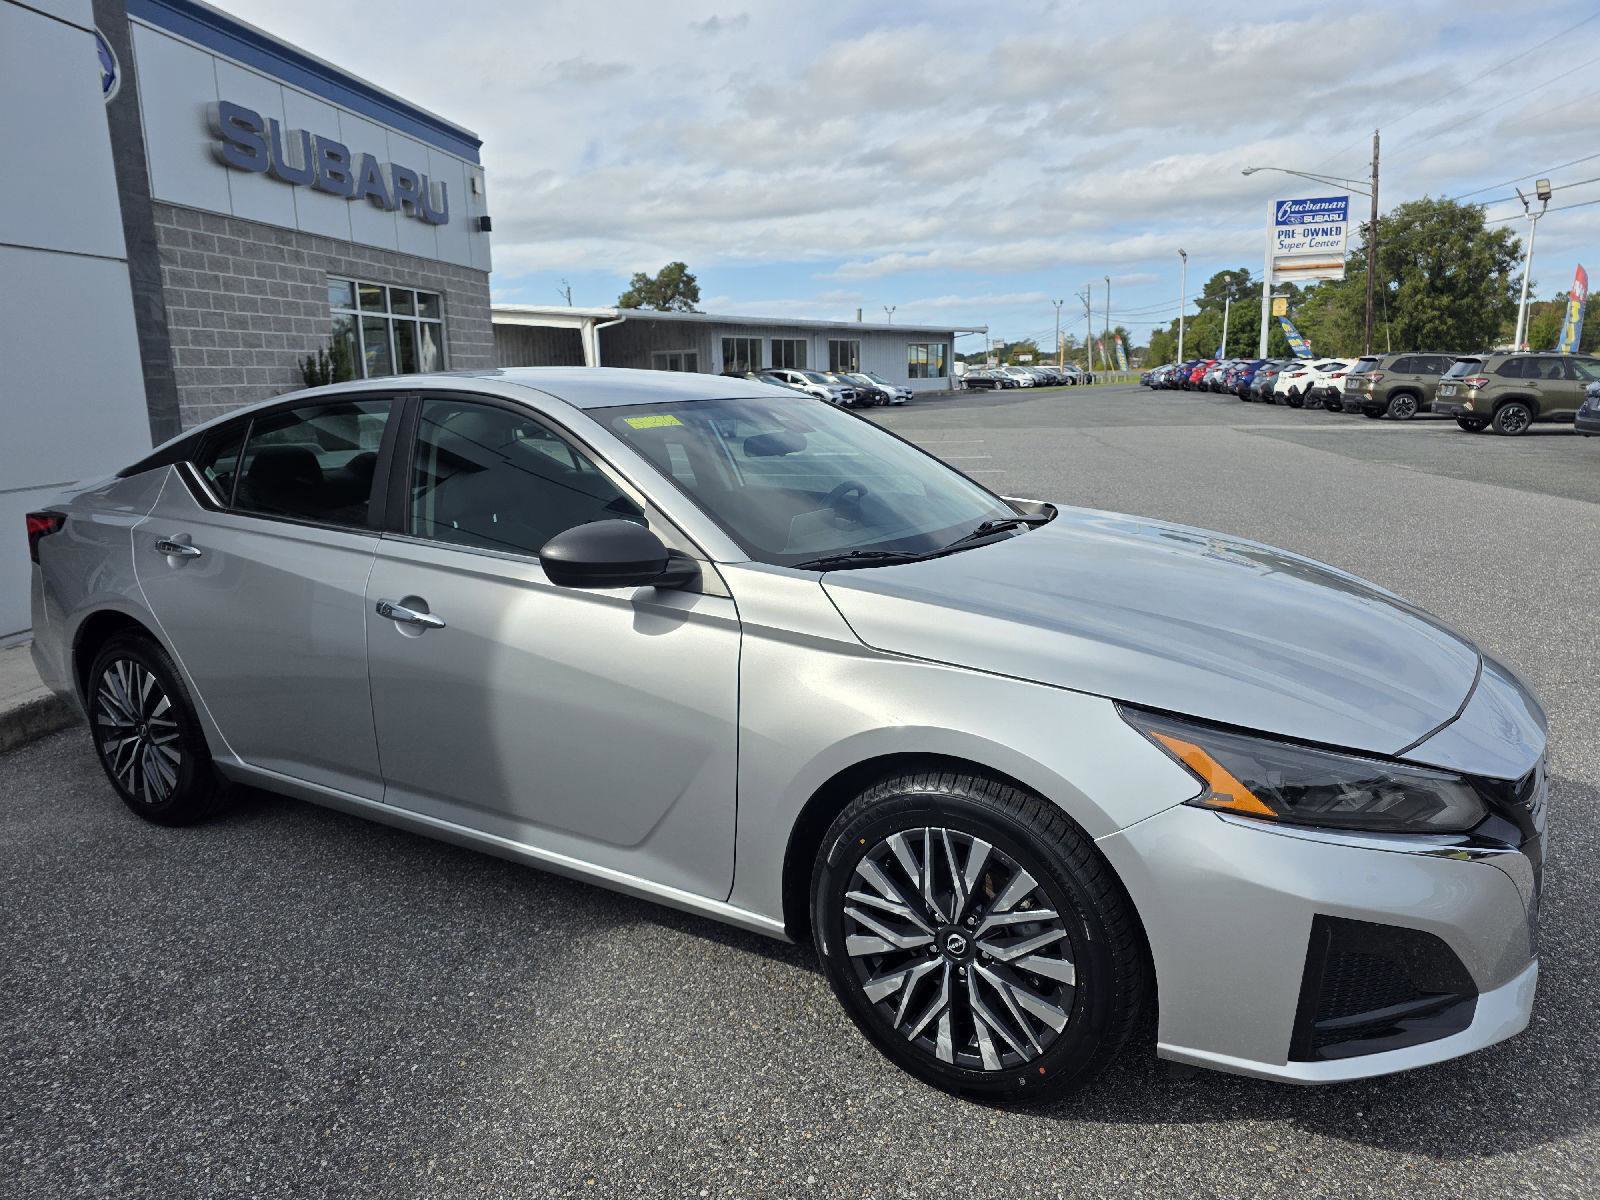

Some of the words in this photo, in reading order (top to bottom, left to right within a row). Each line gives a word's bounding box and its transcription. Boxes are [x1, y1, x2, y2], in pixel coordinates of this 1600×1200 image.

[211, 100, 449, 225] SUBARU
[1278, 200, 1346, 221] Buchanan
[1303, 213, 1343, 223] SUBARU
[1278, 239, 1306, 252] Super
[1308, 238, 1341, 248] Center
